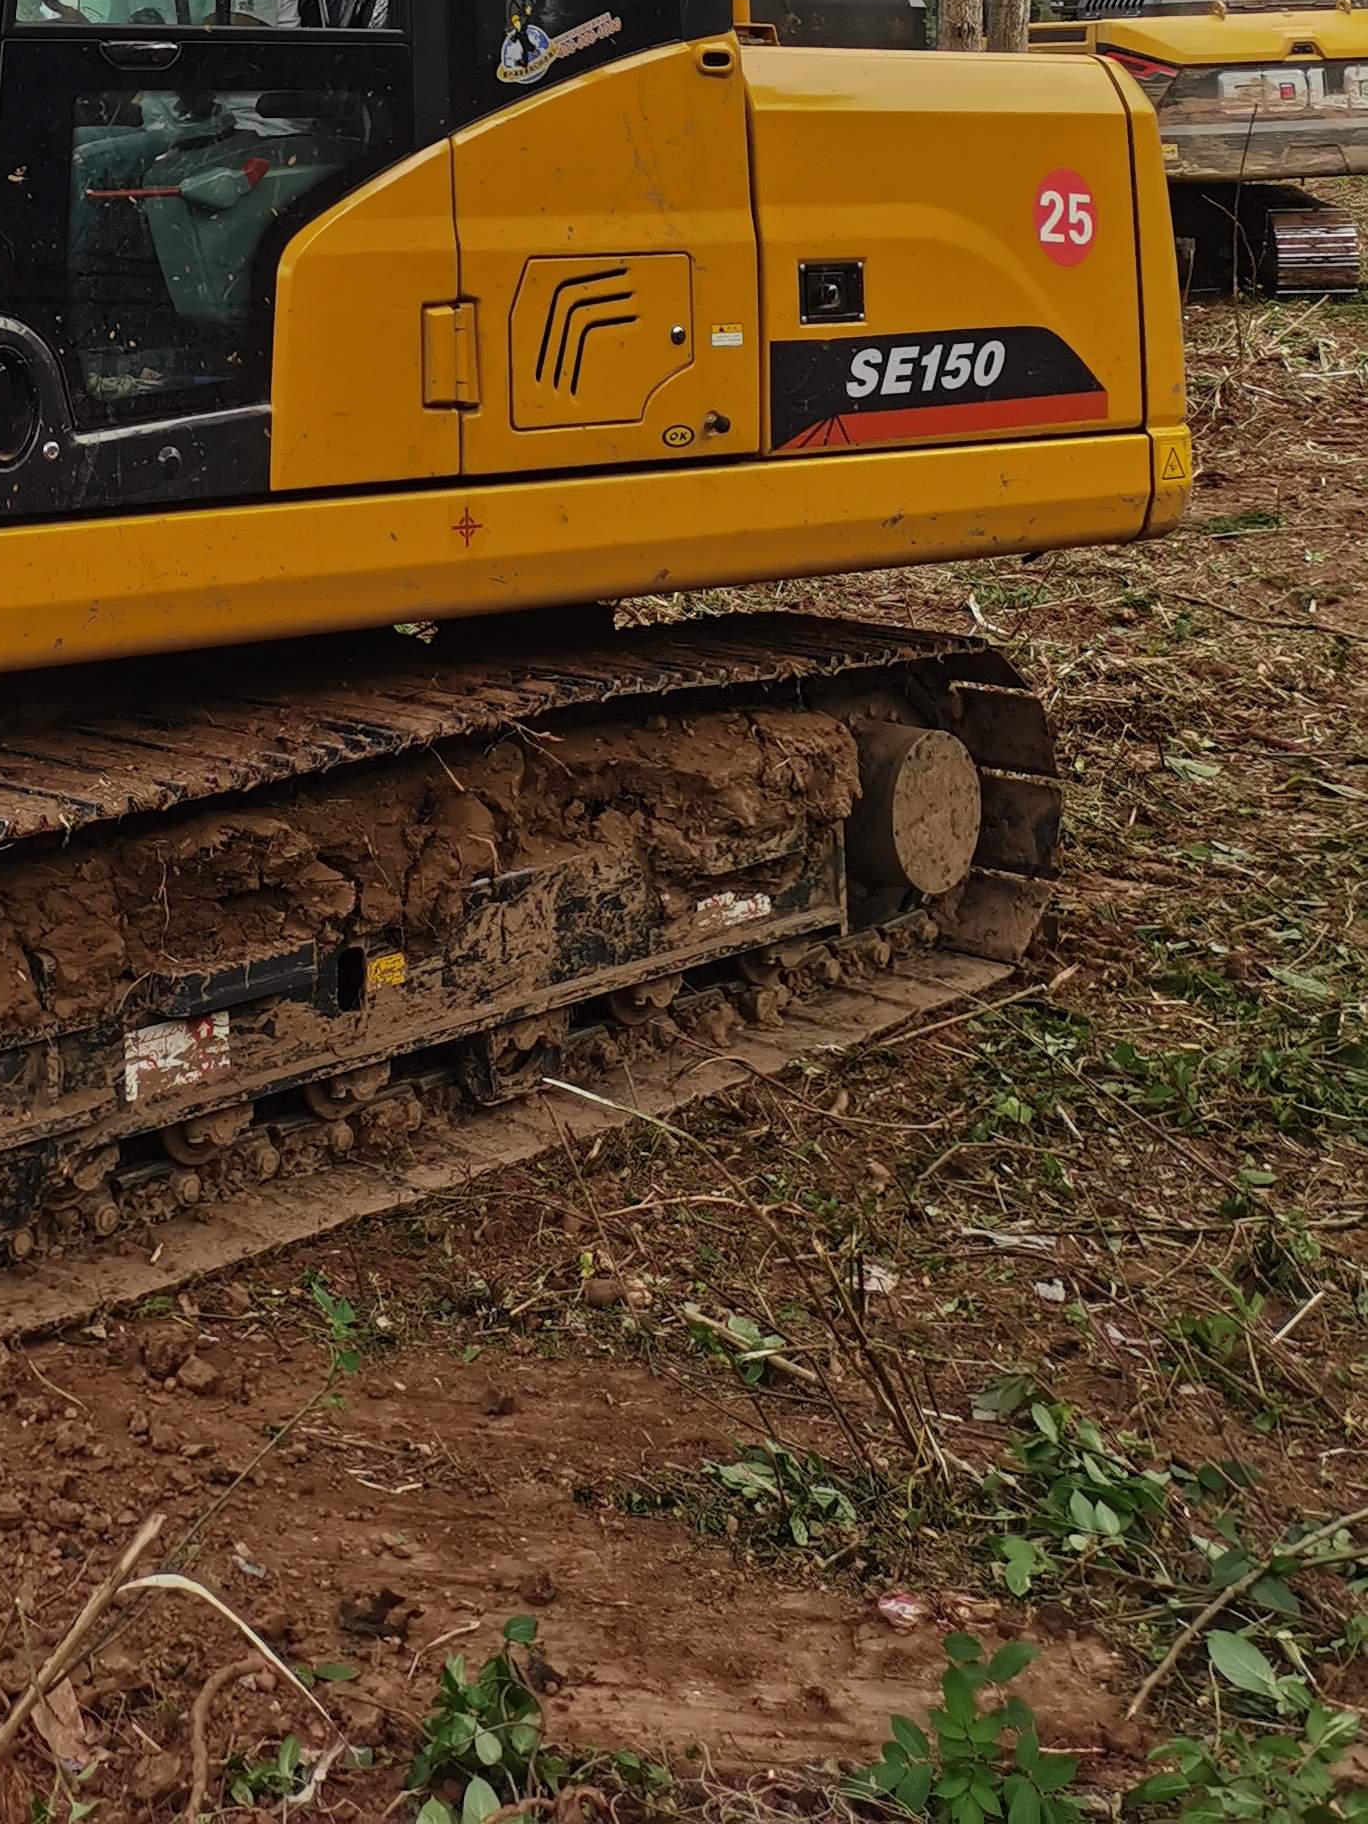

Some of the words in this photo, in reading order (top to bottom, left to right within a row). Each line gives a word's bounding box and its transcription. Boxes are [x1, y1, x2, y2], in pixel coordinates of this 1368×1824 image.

[1039, 190, 1093, 245] 25
[846, 340, 1006, 398] SE150
[669, 431, 688, 442] OK
